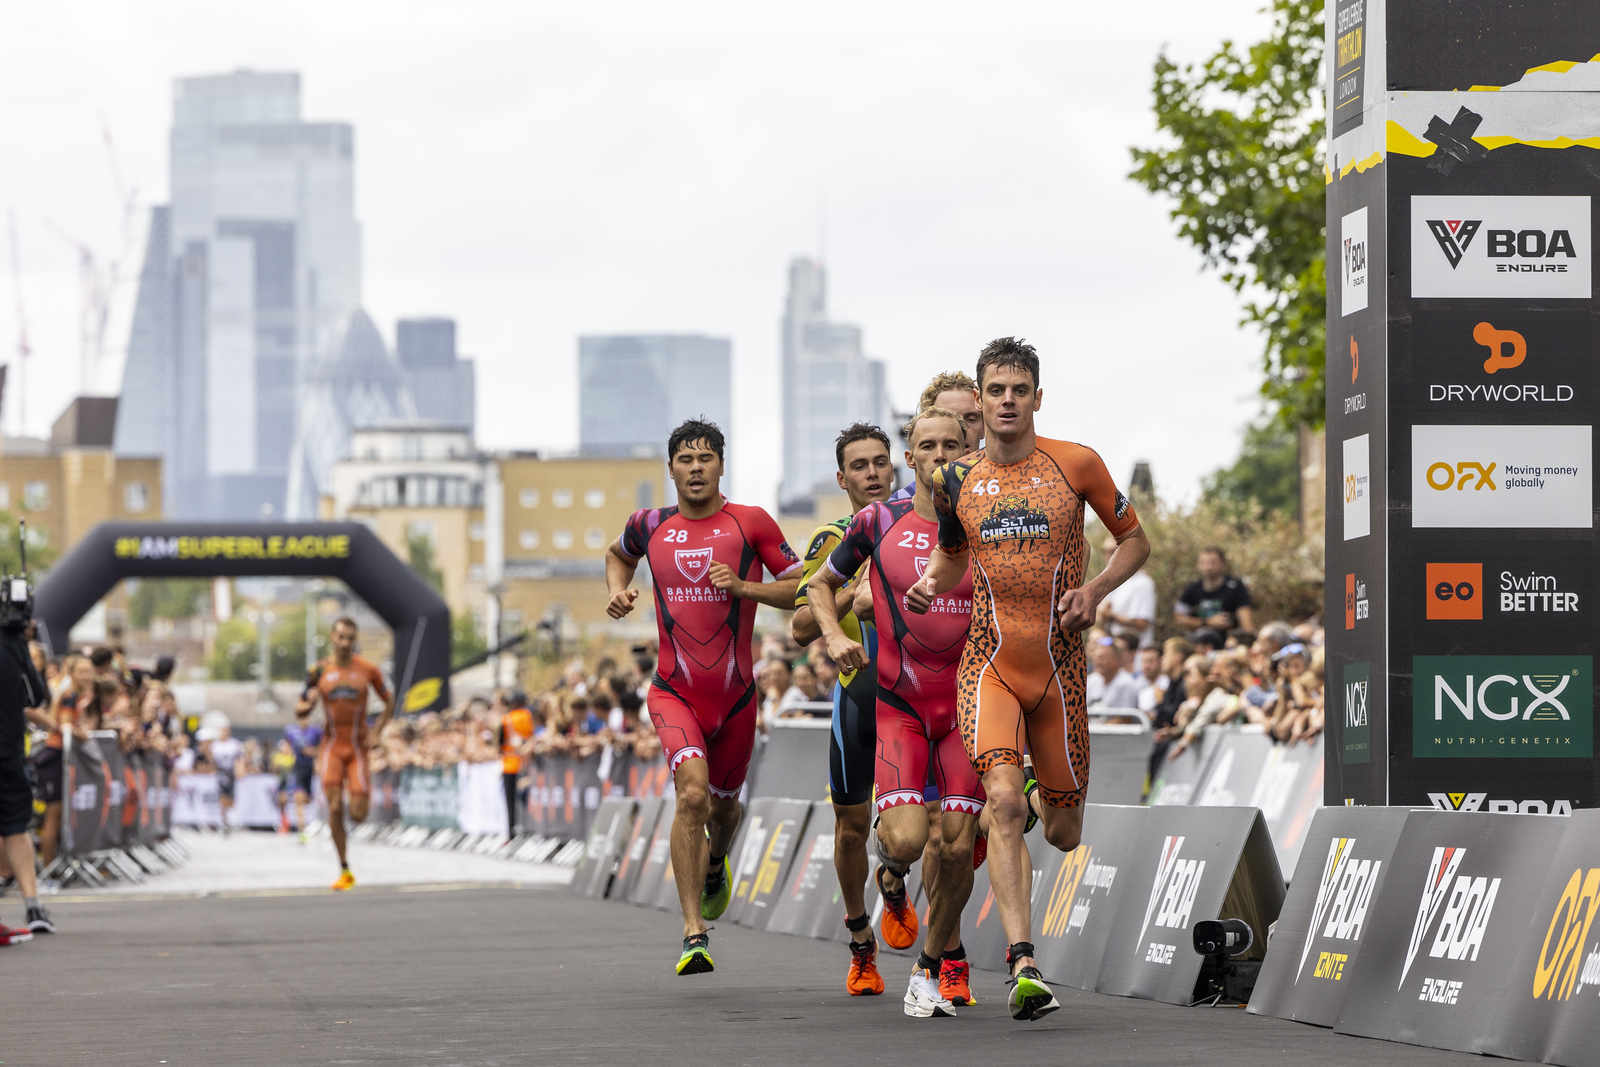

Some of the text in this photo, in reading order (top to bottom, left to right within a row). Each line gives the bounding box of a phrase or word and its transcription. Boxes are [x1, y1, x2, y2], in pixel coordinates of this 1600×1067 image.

[1339, 76, 1357, 99] LONDON
[1487, 229, 1577, 258] BOA
[1352, 241, 1366, 273] BOA
[1496, 264, 1568, 273] ENDURE
[1344, 392, 1367, 414] DRYWORLD
[1429, 384, 1574, 402] DRYWORLD
[1426, 461, 1497, 491] OFX
[1505, 464, 1578, 477] Moving money
[972, 478, 1001, 497] 46
[1345, 474, 1357, 504] OFX
[1505, 477, 1545, 490] globally
[663, 528, 689, 544] 28
[897, 530, 930, 550] 25
[981, 524, 1050, 543] CHEETAHS
[686, 560, 702, 569] 13
[1500, 570, 1557, 591] Swim
[666, 586, 728, 596] BAHRAIN
[667, 594, 728, 602] VICTORIOUS
[1434, 581, 1475, 601] eo
[902, 595, 972, 608] BRAIN
[903, 604, 971, 614] VORIOUS
[1500, 592, 1579, 612] BETTER
[1345, 681, 1368, 728] NGX
[1434, 674, 1571, 721] NGX
[1434, 737, 1571, 745] NUTRI-GENETIX
[1154, 858, 1207, 930] BOA
[1323, 858, 1382, 941] BOA
[1429, 875, 1502, 962] BOA
[1313, 951, 1349, 981] IGNITE
[1418, 977, 1464, 1005] ENDURE
